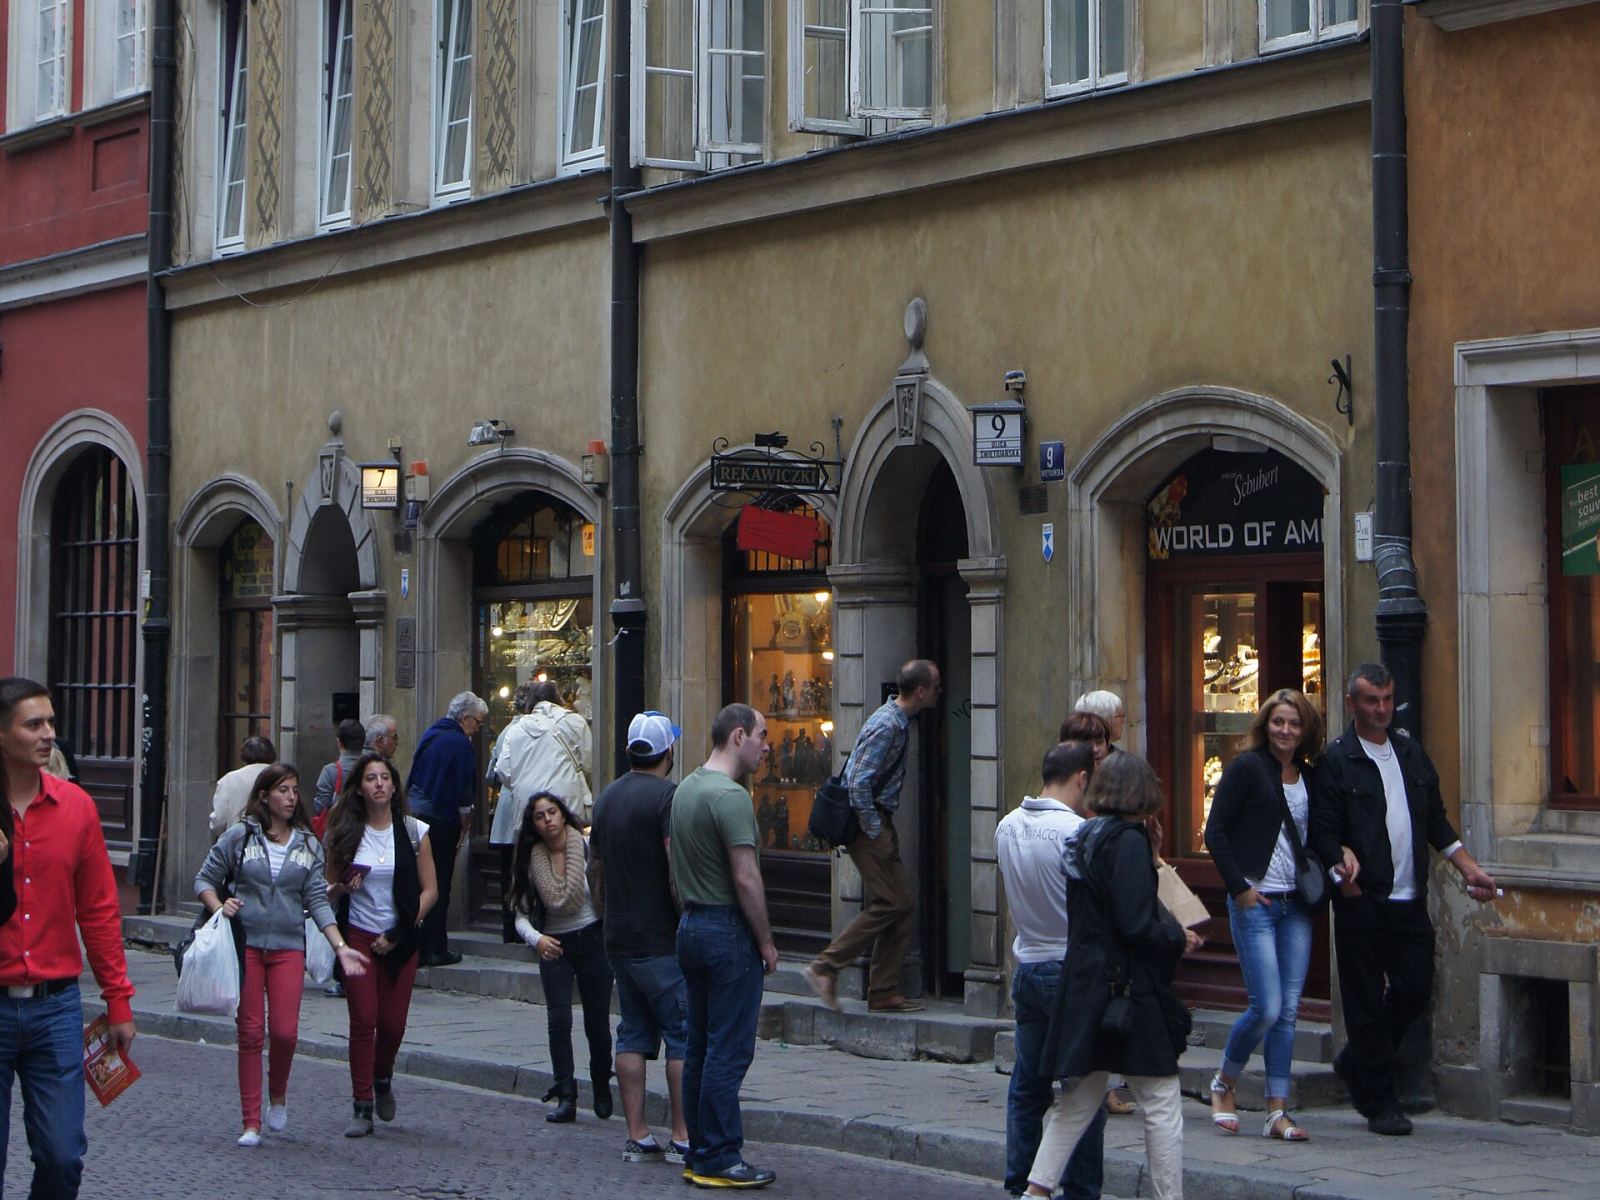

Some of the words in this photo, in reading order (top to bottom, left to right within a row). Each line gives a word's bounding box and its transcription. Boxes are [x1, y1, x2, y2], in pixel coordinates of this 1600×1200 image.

[991, 414, 1006, 438] 9
[1046, 447, 1054, 469] 9
[377, 469, 386, 489] 7
[720, 466, 817, 484] RĘKAWICZKI
[1233, 465, 1279, 506] Schubert
[1577, 484, 1599, 504] best
[1154, 522, 1234, 551] WORLD
[1244, 521, 1276, 547] OF
[1284, 518, 1324, 545] AM
